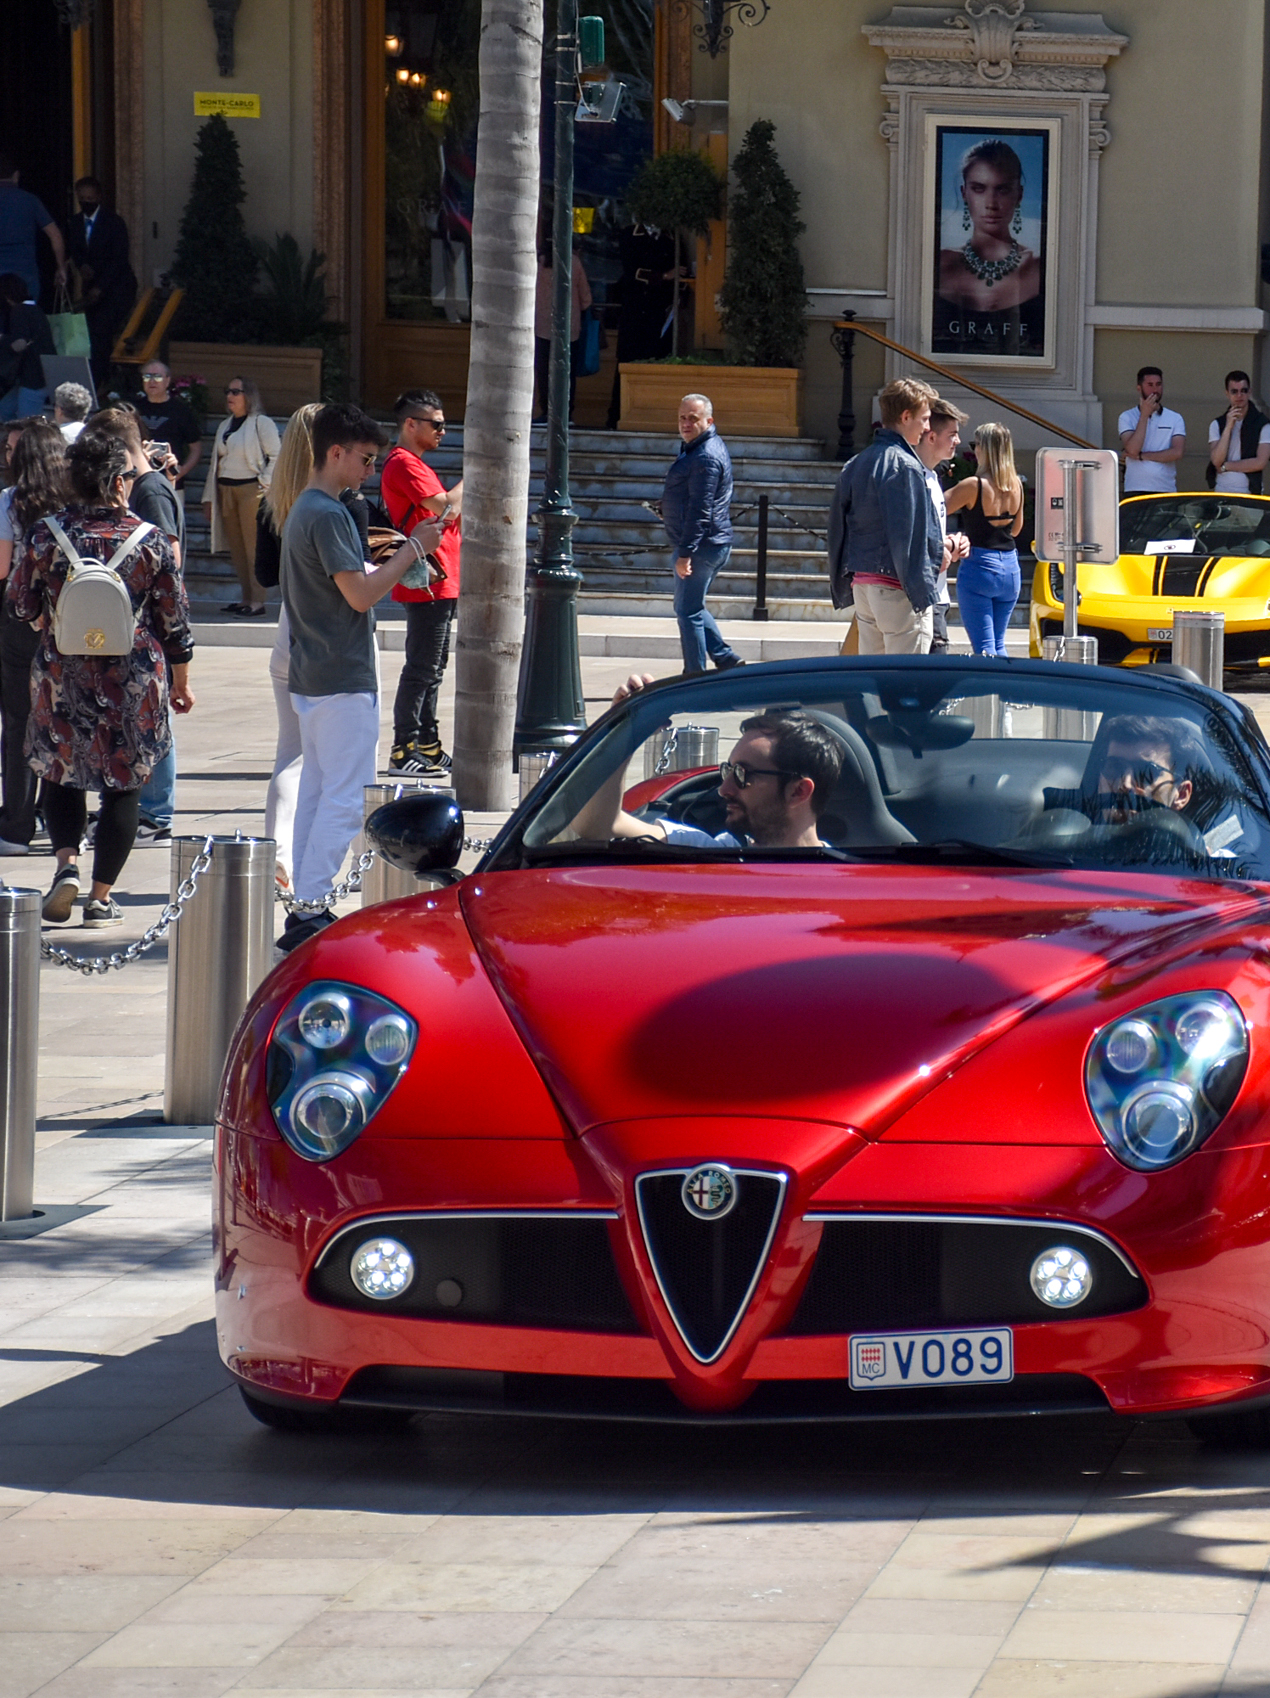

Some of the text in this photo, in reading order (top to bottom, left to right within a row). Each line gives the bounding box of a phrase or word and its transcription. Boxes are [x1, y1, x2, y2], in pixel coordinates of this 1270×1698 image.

[200, 99, 254, 107] MONTE-CARLO
[949, 321, 1028, 336] GRAFF
[1158, 630, 1173, 640] 02
[862, 1363, 880, 1374] MC
